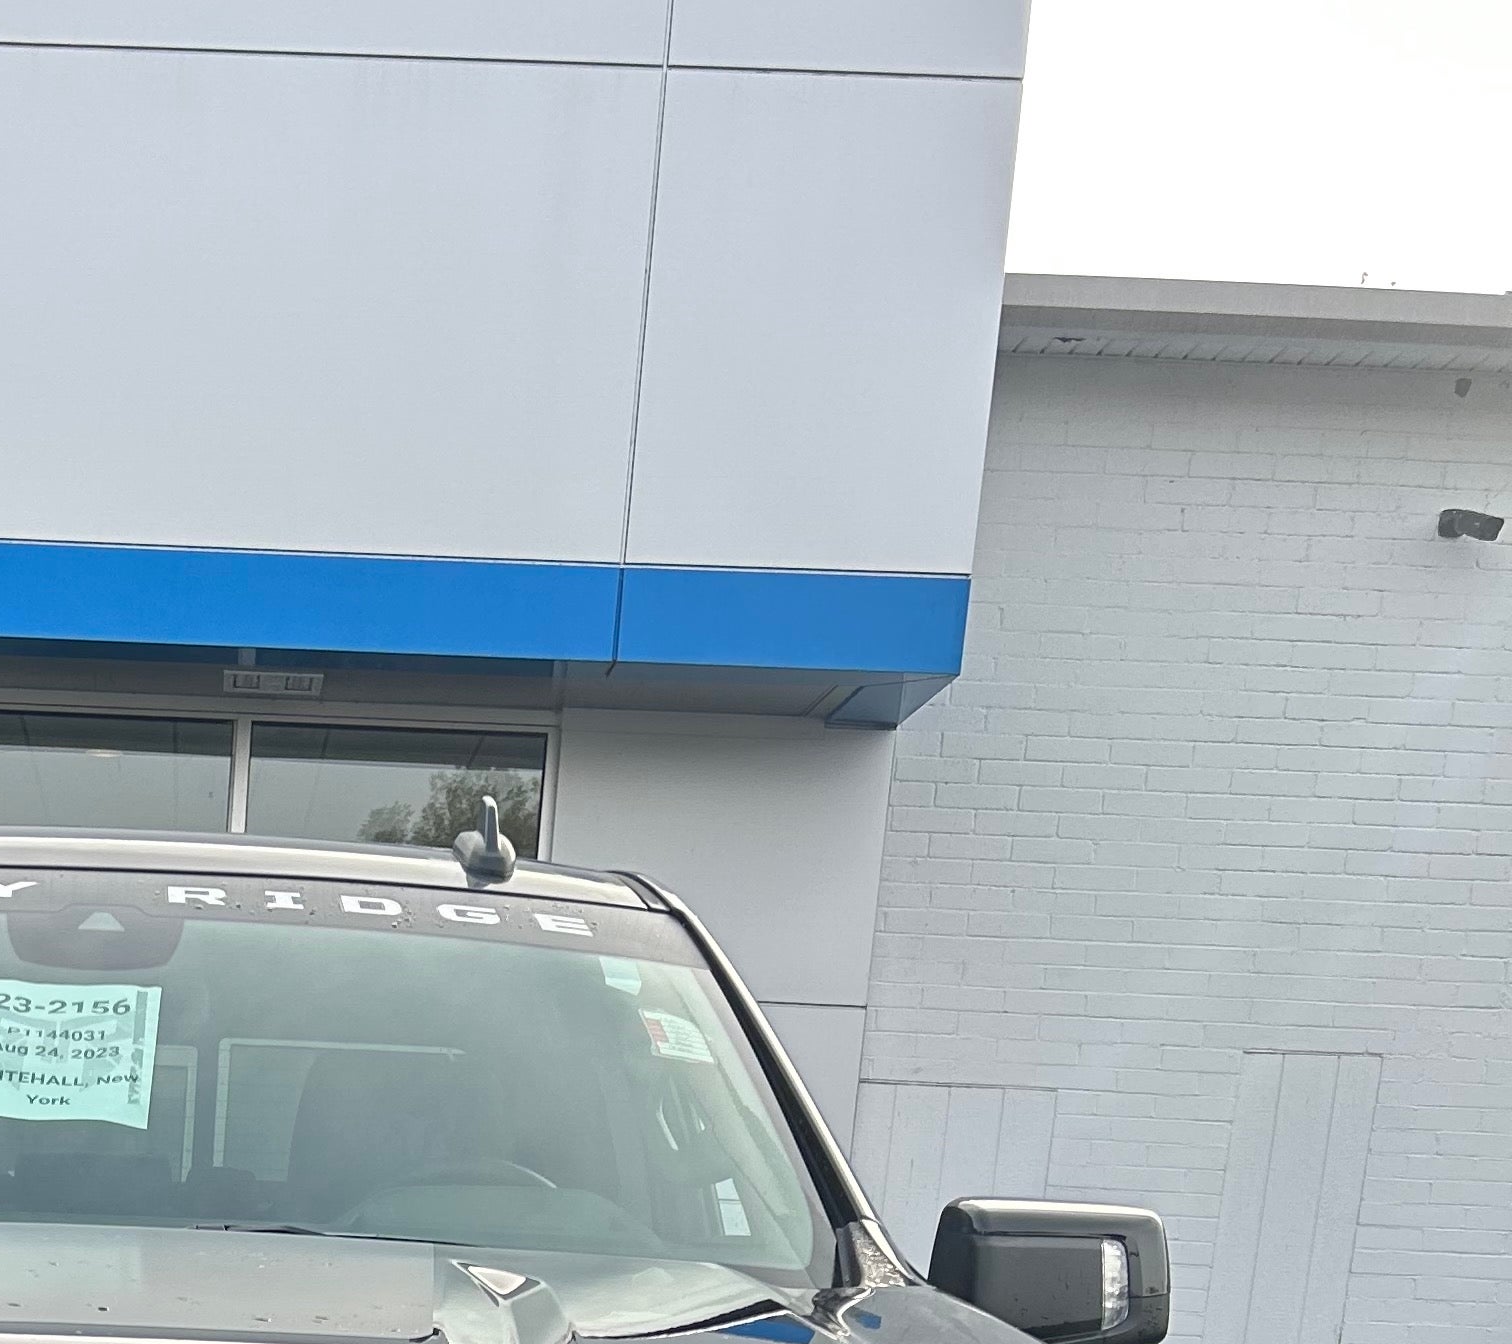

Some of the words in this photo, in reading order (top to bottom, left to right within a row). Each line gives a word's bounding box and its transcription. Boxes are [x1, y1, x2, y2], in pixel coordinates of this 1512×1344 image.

[166, 885, 596, 938] RIDGE
[7, 1026, 106, 1042] P1144031
[34, 1045, 65, 1060] 24,
[70, 1045, 120, 1060] 2023
[95, 1073, 140, 1086] New
[25, 1093, 72, 1107] York
